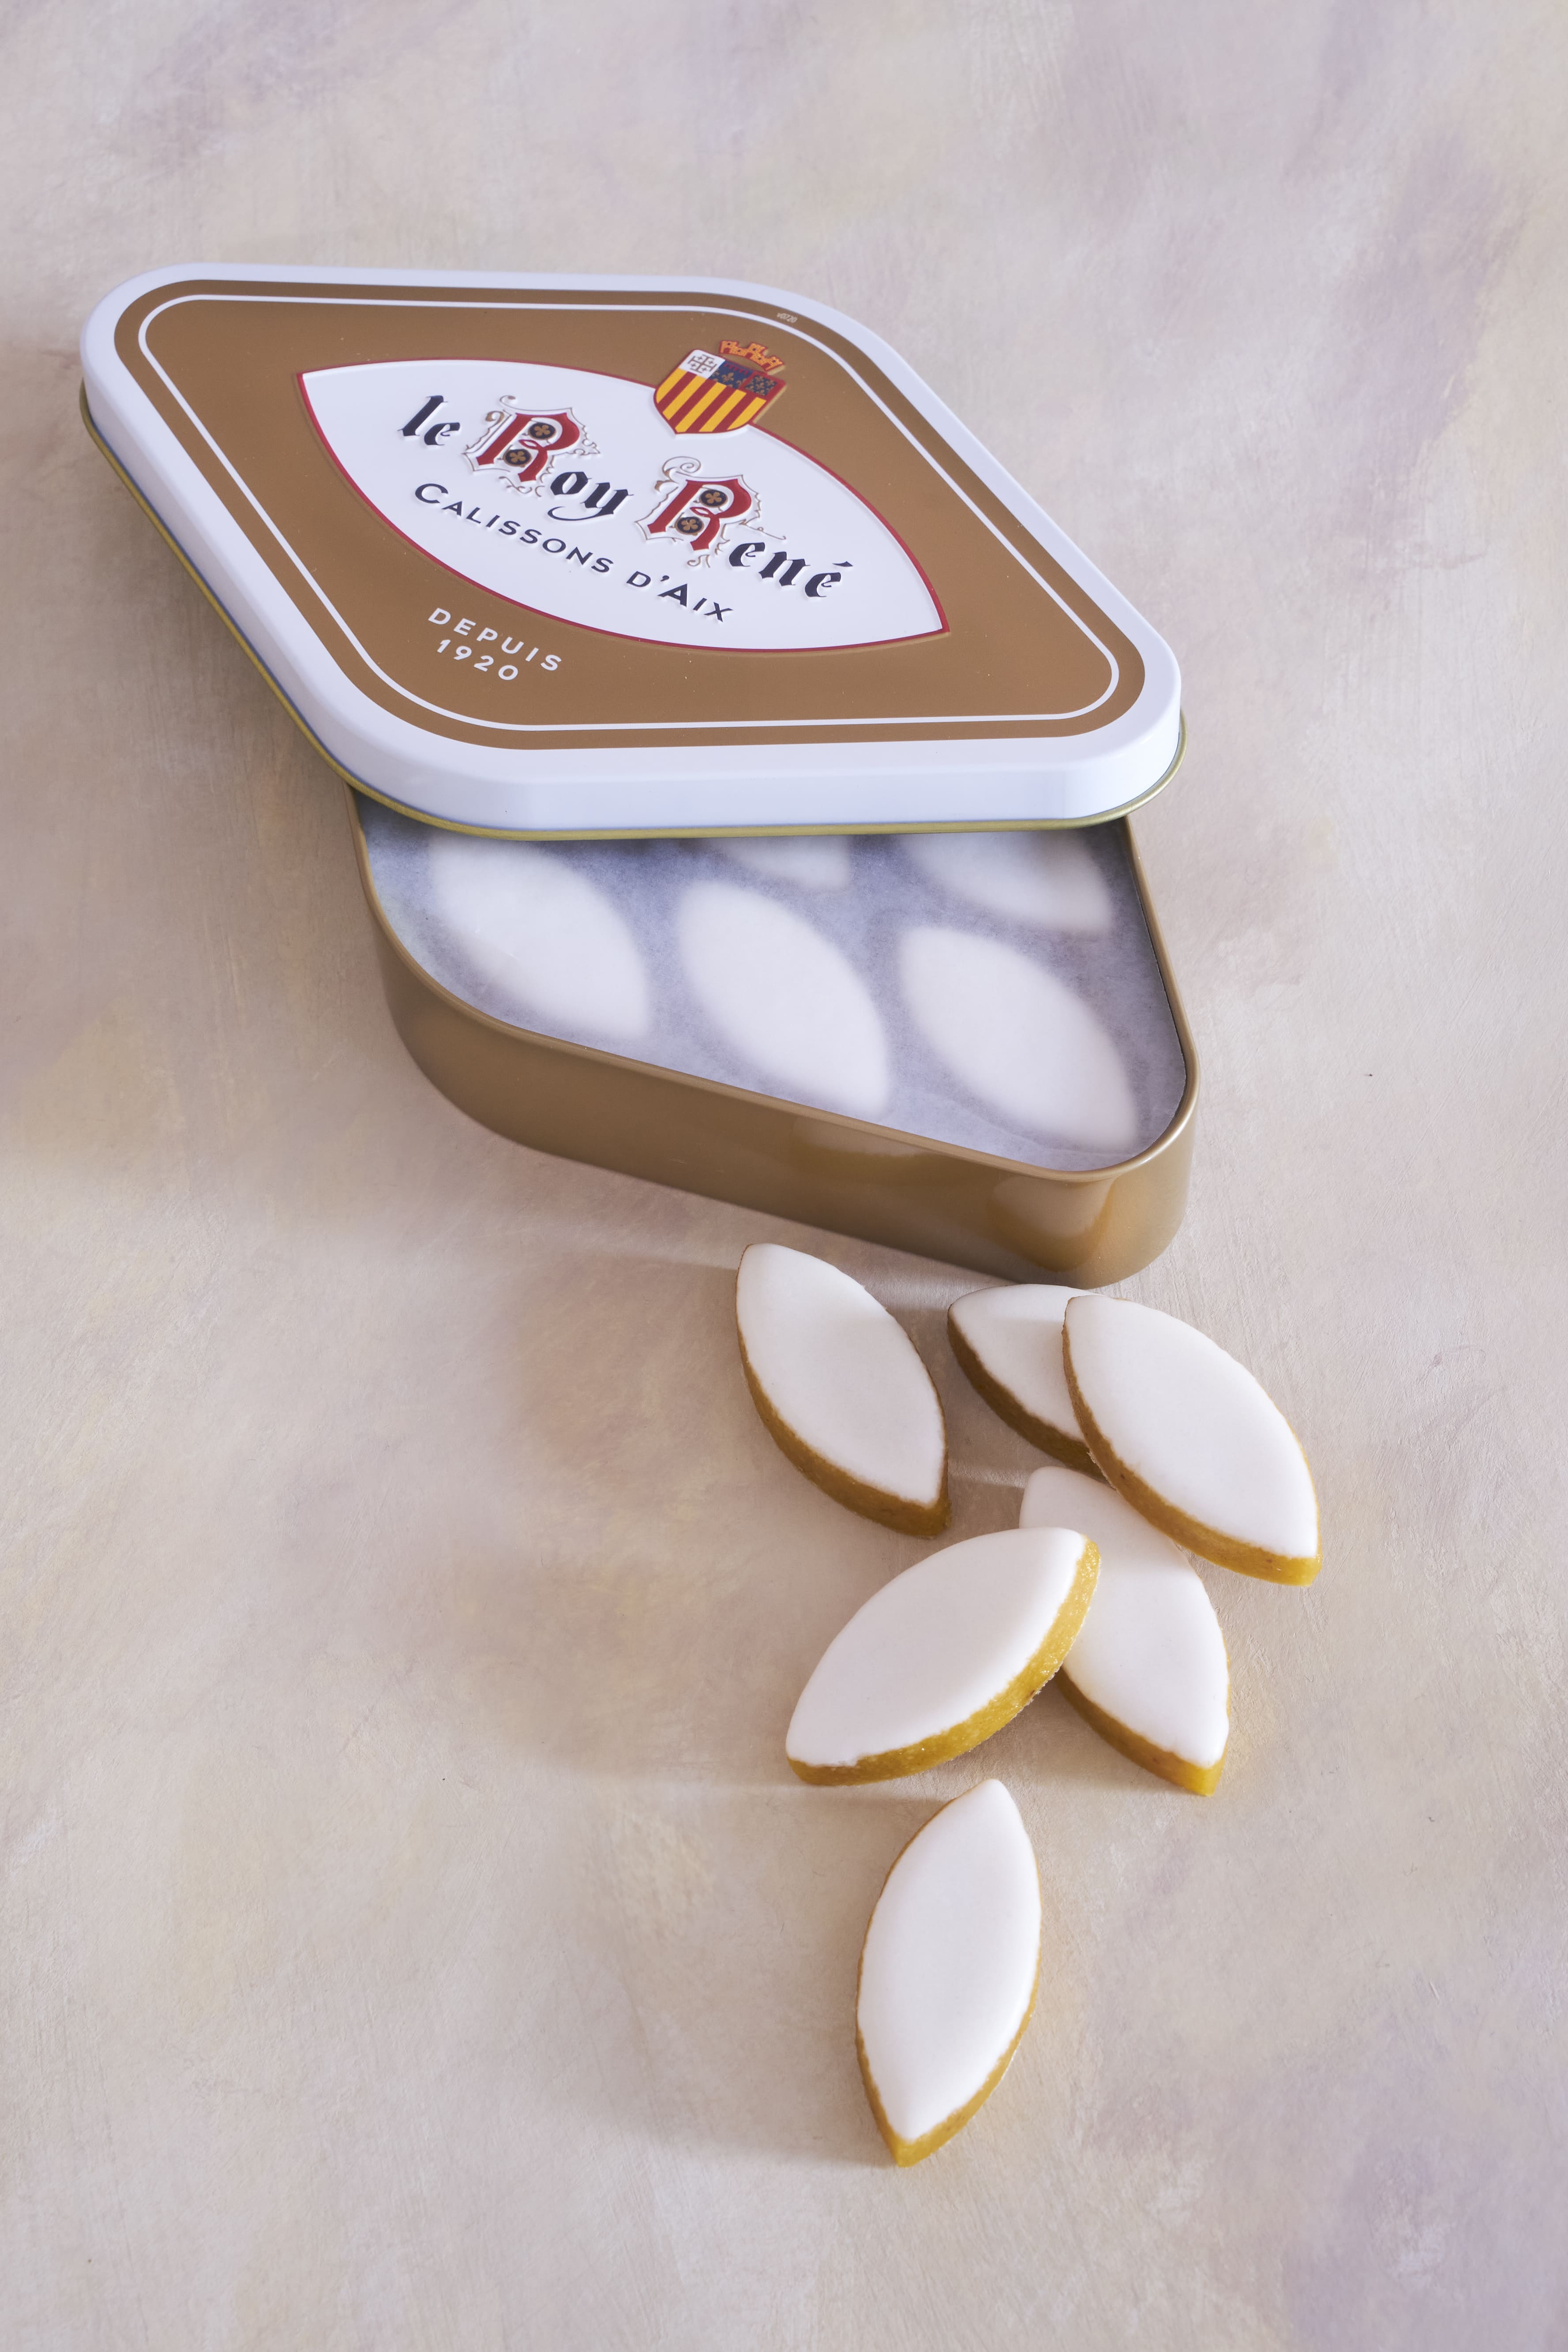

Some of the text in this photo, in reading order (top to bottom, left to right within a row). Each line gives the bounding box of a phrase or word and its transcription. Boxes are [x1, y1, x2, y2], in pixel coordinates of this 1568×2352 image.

[398, 395, 853, 597] le Roy René
[415, 483, 733, 623] CALISSONS D'AIX
[428, 608, 562, 671] DEPUIS
[436, 639, 518, 681] 1920
